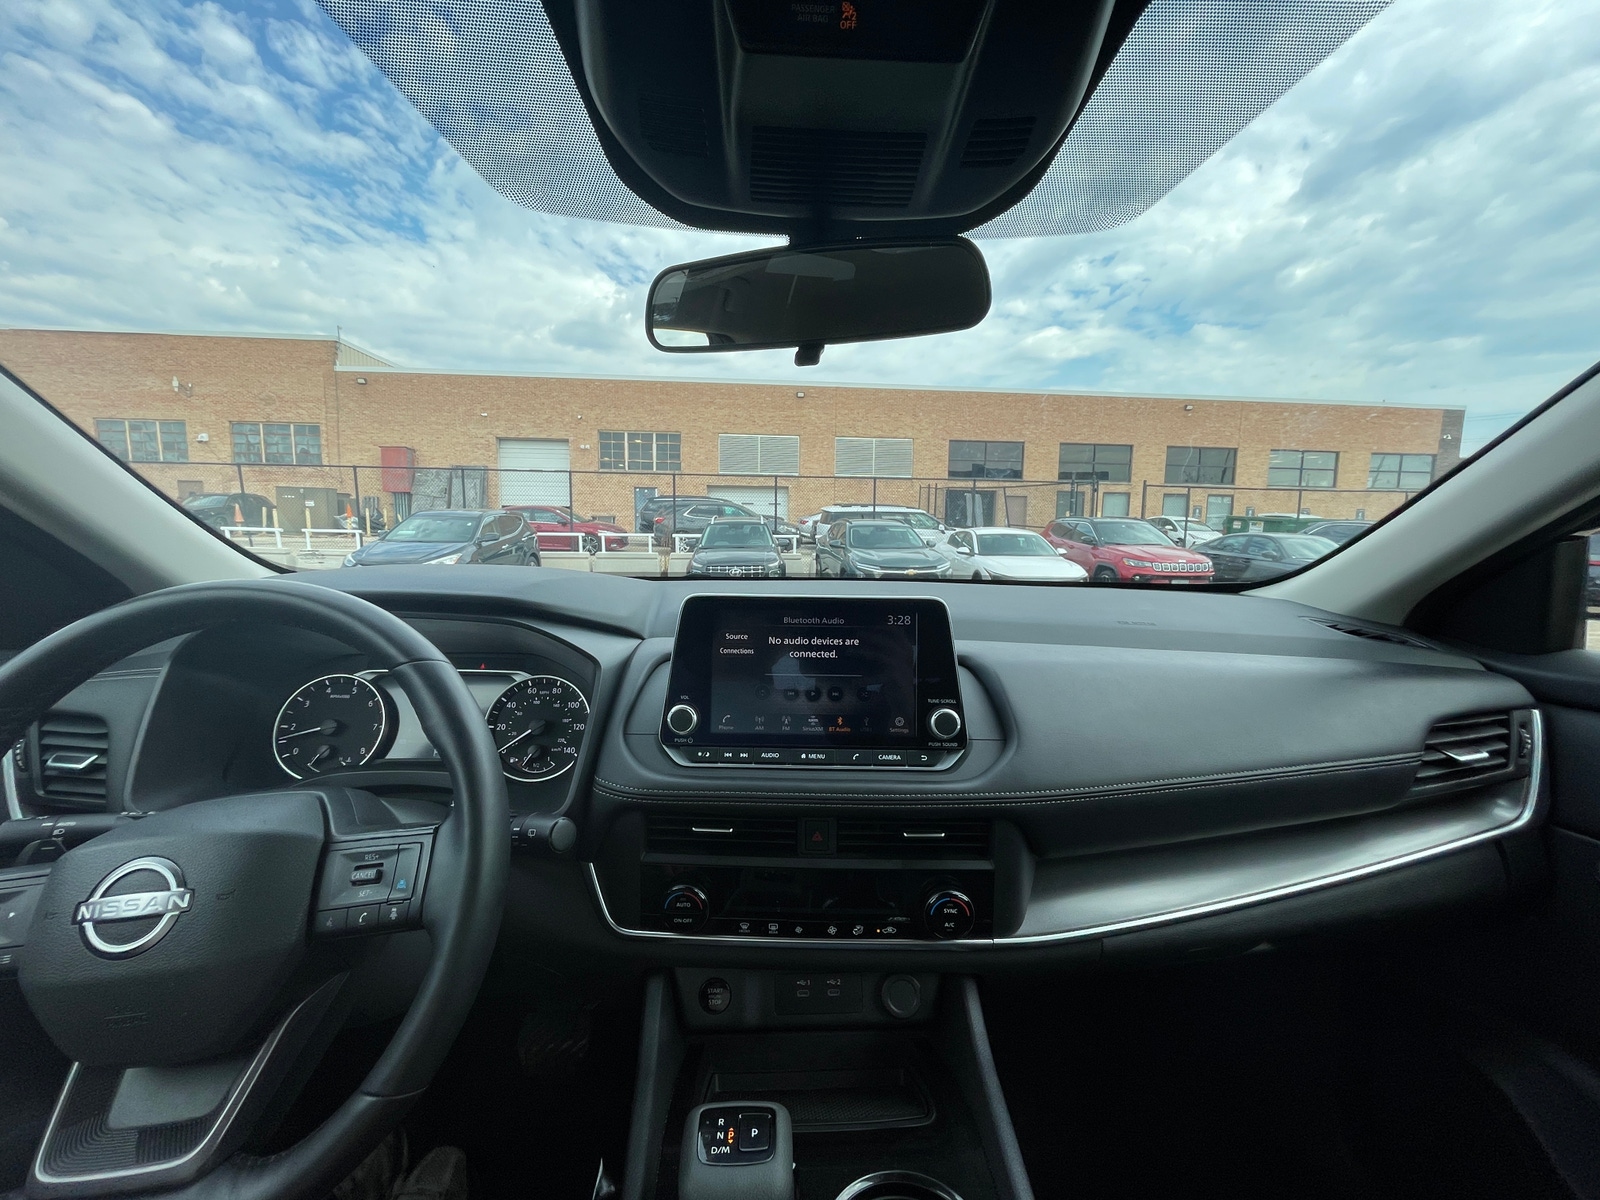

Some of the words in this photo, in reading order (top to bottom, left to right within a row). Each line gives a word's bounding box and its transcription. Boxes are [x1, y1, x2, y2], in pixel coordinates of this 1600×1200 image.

[791, 4, 836, 14] PASSENGER
[797, 13, 810, 22] AIR
[812, 14, 829, 23] BAG
[839, 20, 858, 30] OFF
[783, 617, 820, 625] Bluetooth
[821, 617, 845, 626] Audio
[887, 616, 911, 625] 3:28
[725, 633, 749, 641] Source
[768, 636, 781, 645] No
[783, 636, 809, 646] audio
[811, 637, 843, 646] devices
[719, 647, 755, 655] Connections
[789, 648, 839, 659] connected.
[304, 700, 310, 708] 3
[290, 723, 296, 731] 2
[351, 871, 376, 880] CANCEL
[77, 893, 191, 921] NISSAN
[718, 1118, 725, 1126] R
[716, 1132, 724, 1140] N
[728, 1131, 735, 1139] P
[751, 1128, 759, 1138] P
[711, 1146, 731, 1154] D/M
